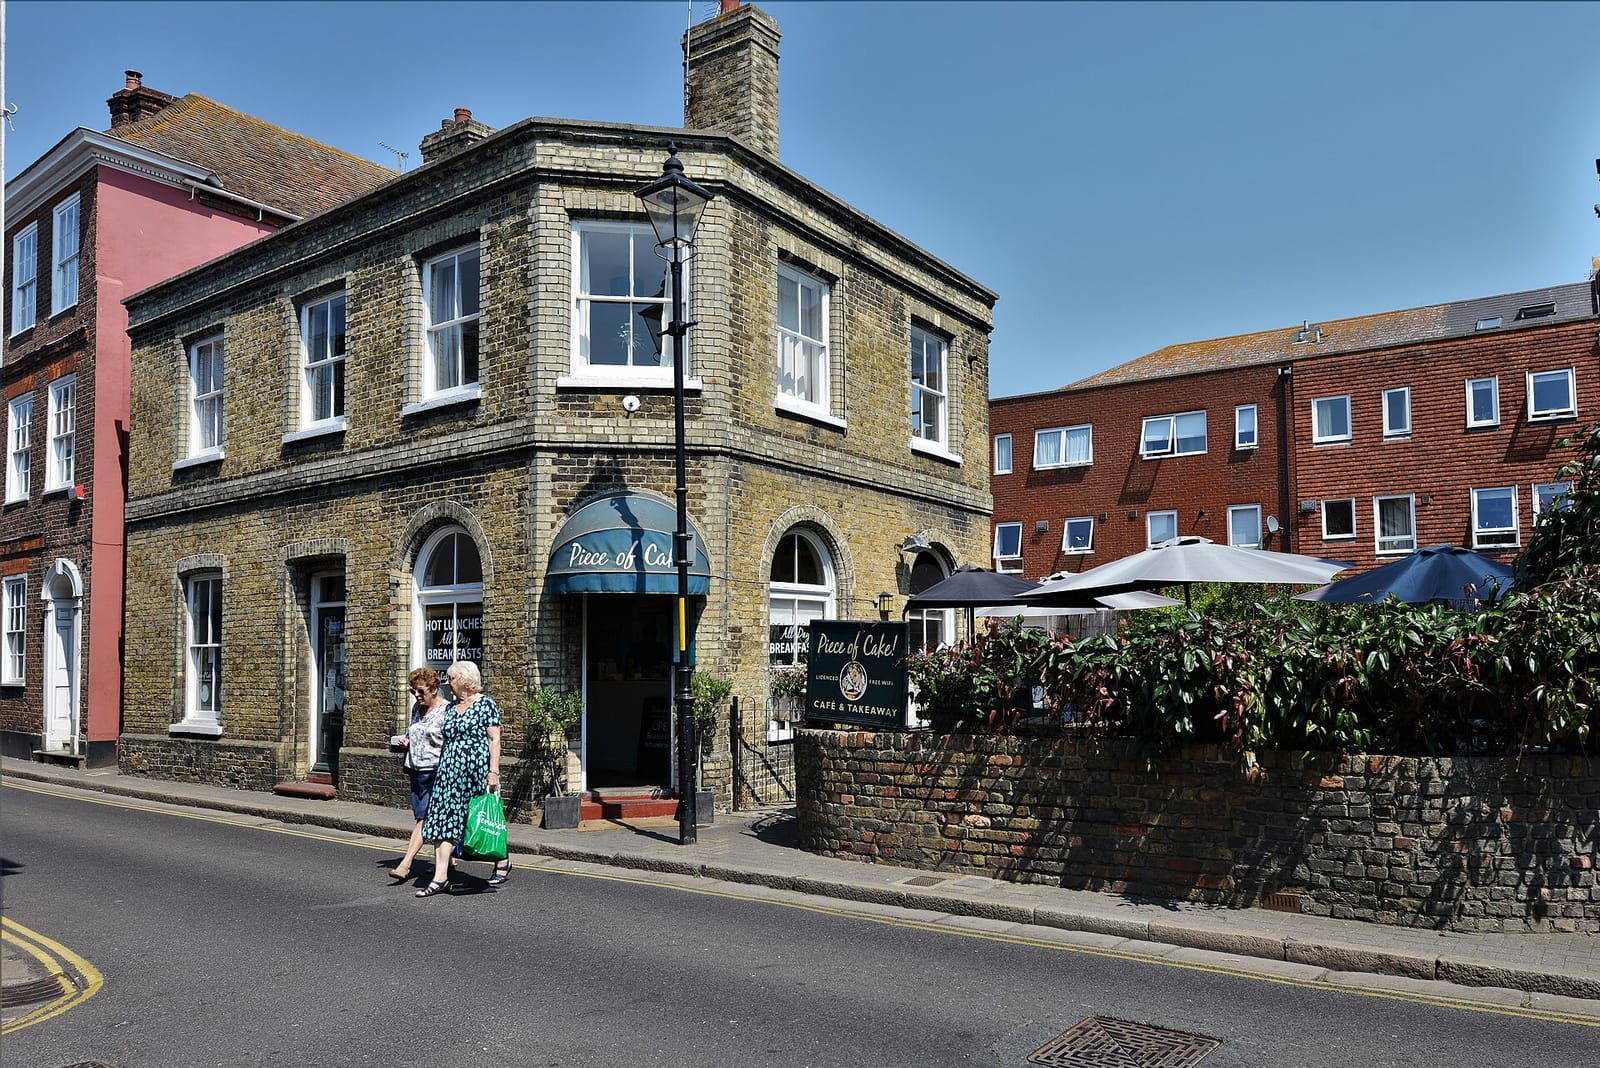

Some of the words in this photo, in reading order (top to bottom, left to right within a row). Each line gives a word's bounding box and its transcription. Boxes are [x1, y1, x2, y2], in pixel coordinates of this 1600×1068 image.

[569, 542, 608, 567] Piece
[615, 540, 638, 570] of
[644, 543, 672, 568] Ca
[425, 619, 442, 631] HOT
[437, 631, 453, 646] All
[456, 631, 471, 649] Day
[780, 626, 795, 640] All
[797, 626, 810, 643] Day
[817, 633, 845, 654] Piece
[847, 630, 858, 660] of
[863, 633, 898, 658] Cake!
[427, 648, 482, 660] BREAKFASTS
[813, 700, 836, 711] CAFÉ
[838, 703, 845, 712] &
[847, 703, 898, 717] TAKEAWAY
